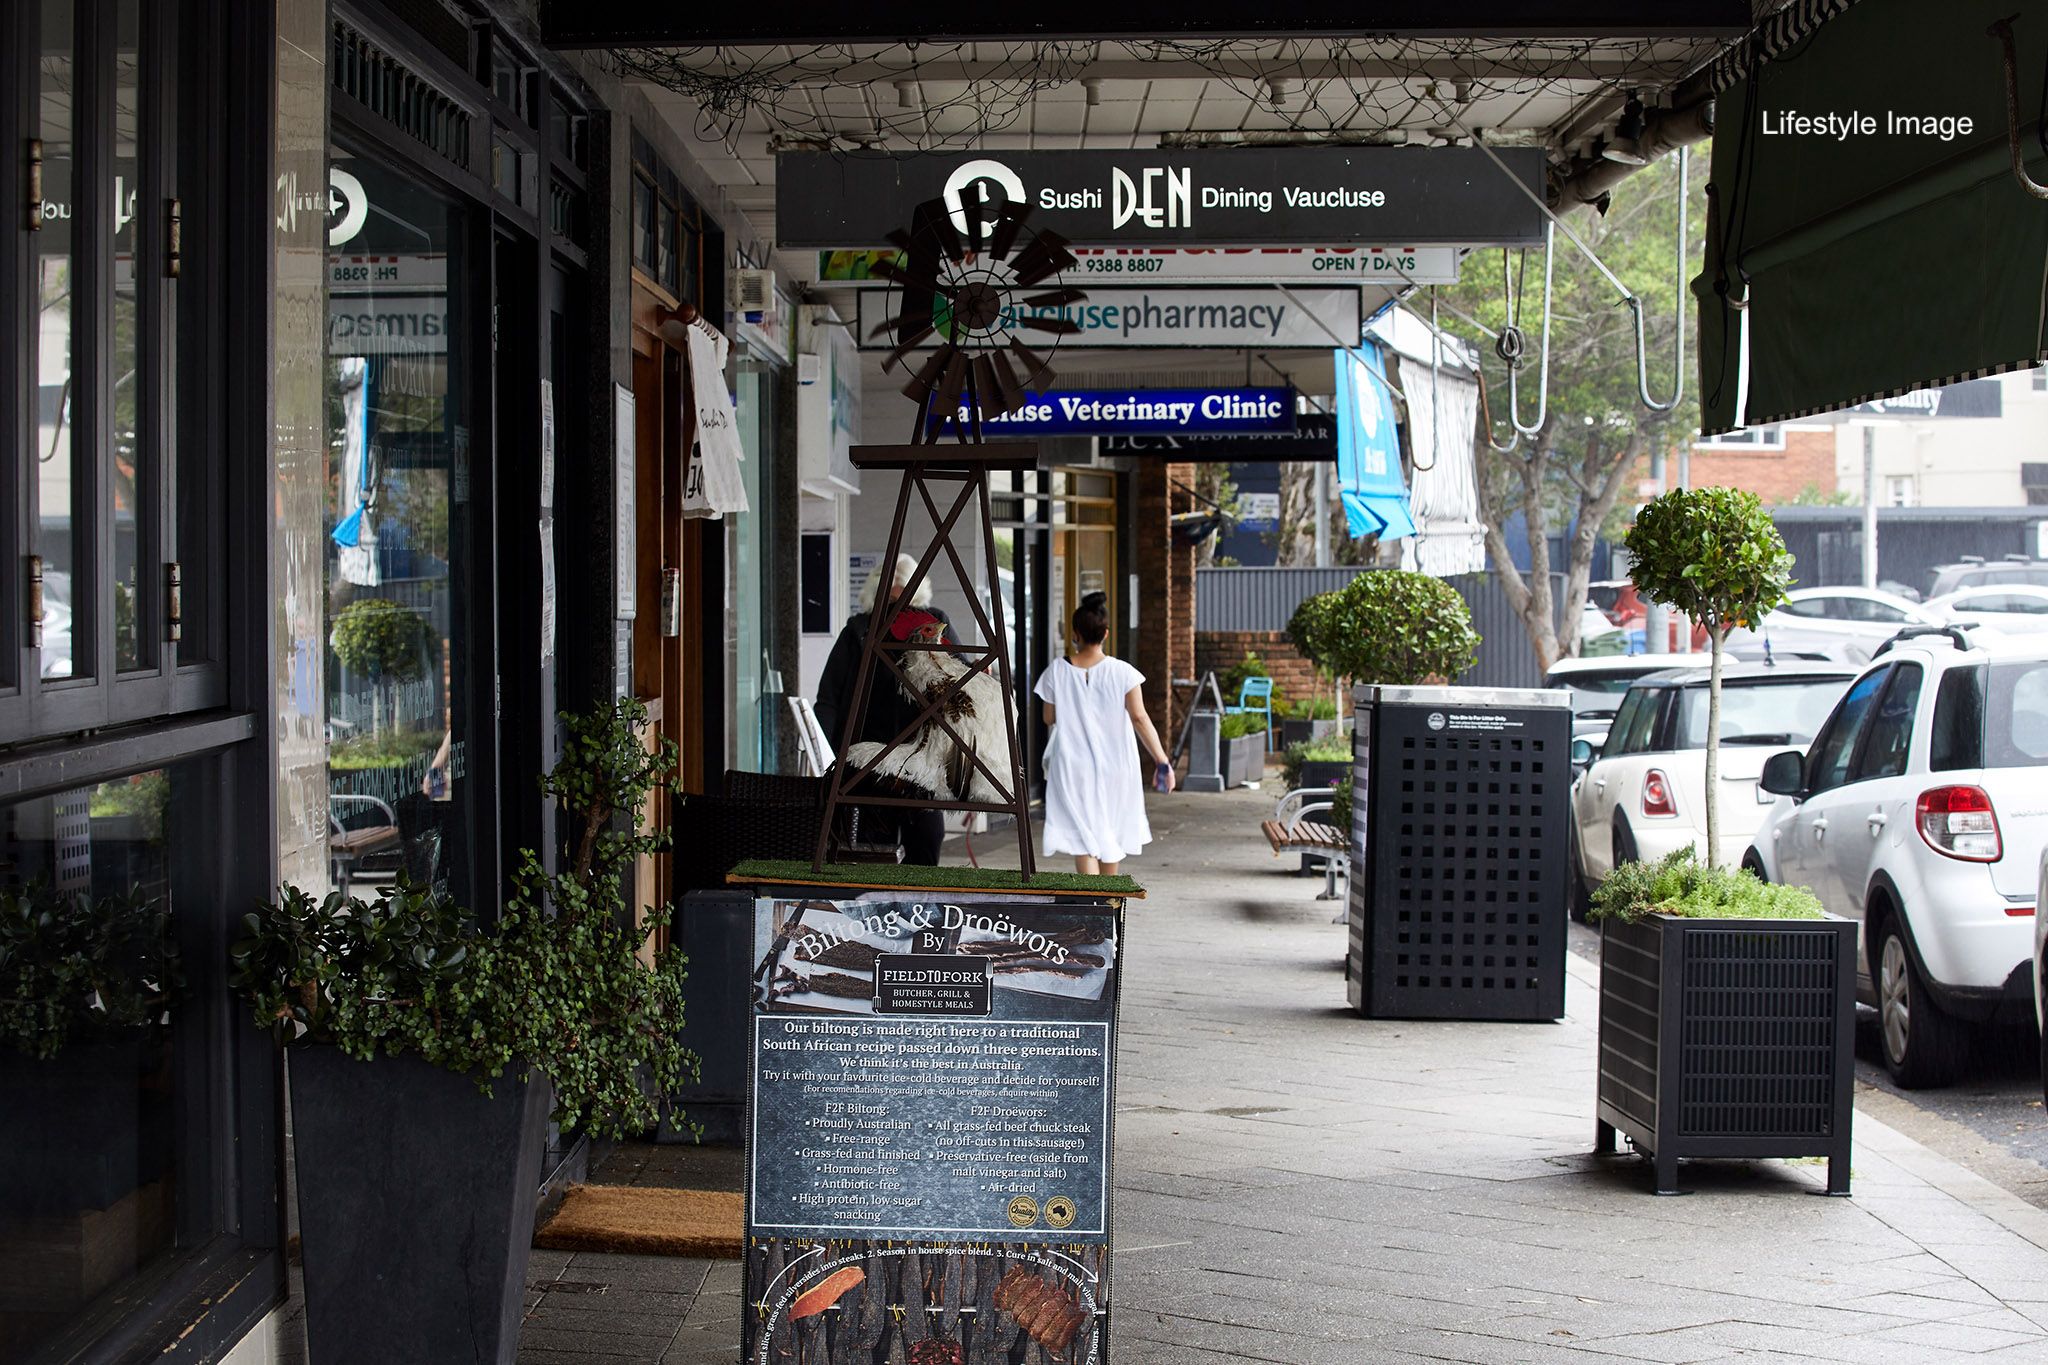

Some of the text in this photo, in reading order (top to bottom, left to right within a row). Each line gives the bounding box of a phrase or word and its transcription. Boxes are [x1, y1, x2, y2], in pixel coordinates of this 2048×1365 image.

[1039, 165, 1385, 230] Sushi DEN Dining Vaucluse
[1086, 259, 1123, 272] 9388
[1128, 259, 1164, 272] 8807
[1312, 257, 1415, 271] OPEN 7 DAYS
[1059, 396, 1195, 425] Veterinary
[1201, 395, 1282, 419] Clinic
[798, 904, 1070, 965] Biltong & Droëwors
[923, 932, 945, 952] By
[893, 989, 936, 999] BUTCHER,
[937, 990, 962, 998] GRILL
[892, 1000, 974, 1009] HOMESTYLE MEALS
[784, 1022, 1080, 1039] Our biltong is made right here to a traditional
[762, 1039, 1101, 1058] South African recipe passed down three generations.
[839, 1057, 1024, 1070] We think it's the best in Australia.
[762, 1069, 1100, 1087] Try it with your favourite ice-cold beverage and decide for yourself!
[804, 1085, 1059, 1098] (For recomendations regarding ice-cold beverages, enquire within)
[825, 1103, 890, 1116] F2F Biltong:
[970, 1106, 1047, 1117] F2F Droëwors:
[812, 1117, 911, 1131] Proudly Australian
[934, 1121, 1091, 1133] All grass-fed beef chuck steak
[832, 1133, 891, 1146] Free-range
[935, 1136, 1085, 1150] (no off-cuts in this sausage!)
[802, 1147, 921, 1160] Grass-fed and finished
[936, 1151, 1089, 1165] Preservative-free (aside from
[823, 1163, 899, 1175] Hormone-free
[952, 1166, 1067, 1180] malt vinegar and salt)
[821, 1179, 900, 1190] Antibiotic-free
[987, 1182, 1036, 1193] Air-dried
[799, 1193, 922, 1207] High protein, low sugar
[834, 1209, 881, 1222] snacking
[867, 1250, 876, 1258] 2.
[876, 1247, 906, 1257] Season
[908, 1247, 917, 1255] in
[918, 1246, 944, 1255] house
[944, 1247, 967, 1256] spice
[968, 1247, 994, 1256] blend.
[996, 1249, 1004, 1257] 3.
[1005, 1251, 1026, 1260] Cure
[838, 1253, 866, 1265] steaks.
[1026, 1253, 1036, 1262] in
[1036, 1256, 1053, 1268] salt
[820, 1261, 837, 1272] into
[1052, 1263, 1068, 1275] and
[785, 1268, 821, 1298] silversides
[1067, 1272, 1084, 1288] malt
[766, 1295, 787, 1332] grass-fed
[761, 1332, 772, 1351] slice
[1091, 1328, 1100, 1355] hours.
